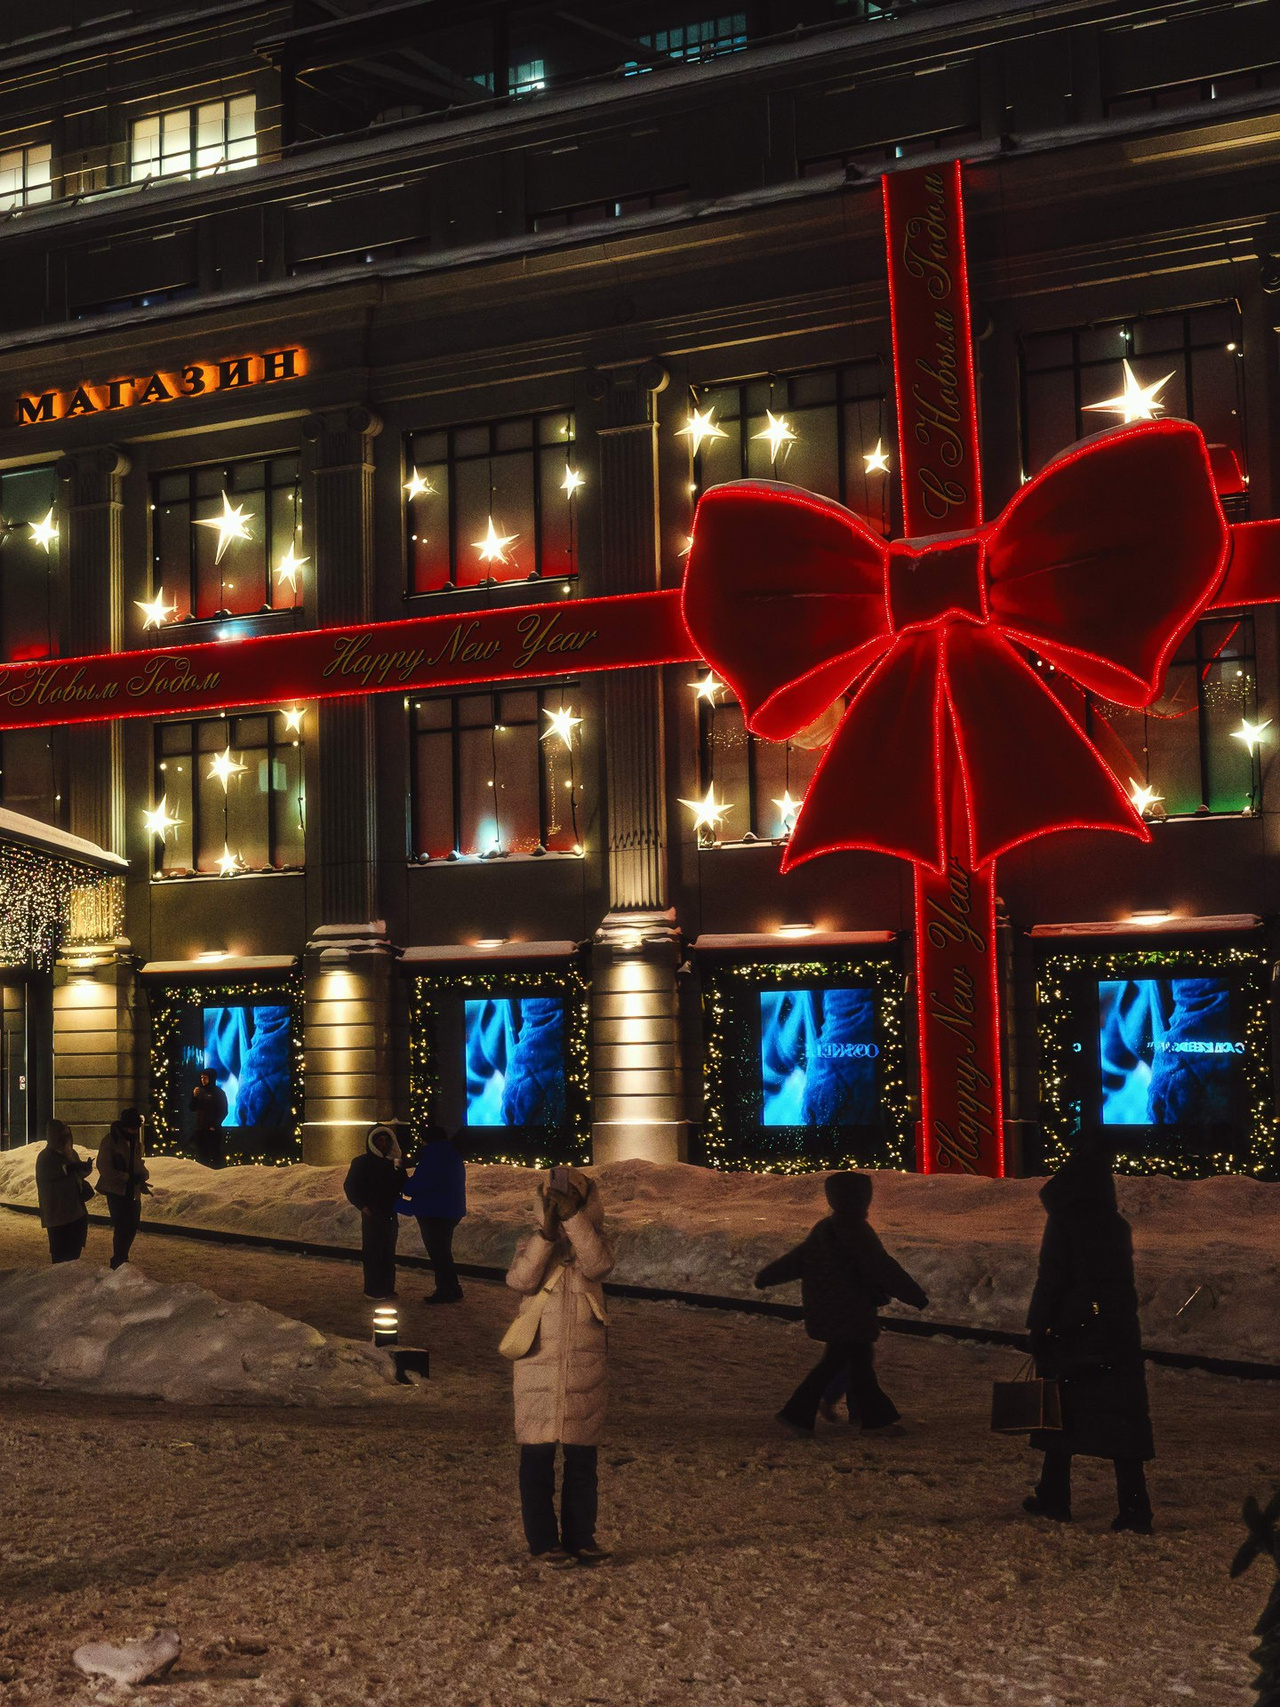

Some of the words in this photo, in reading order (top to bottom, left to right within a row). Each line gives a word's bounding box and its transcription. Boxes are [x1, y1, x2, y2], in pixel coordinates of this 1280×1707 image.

[902, 171, 953, 301] Годом
[18, 348, 300, 426] МАГАЗИН
[911, 308, 966, 468] Новым
[7, 663, 119, 707] Новым
[125, 655, 221, 697] Годом
[322, 632, 425, 686] Happy
[426, 620, 502, 665] New
[512, 611, 599, 669] Year
[926, 855, 986, 953] Year
[929, 964, 976, 1054] New
[933, 1056, 994, 1176] Happy
